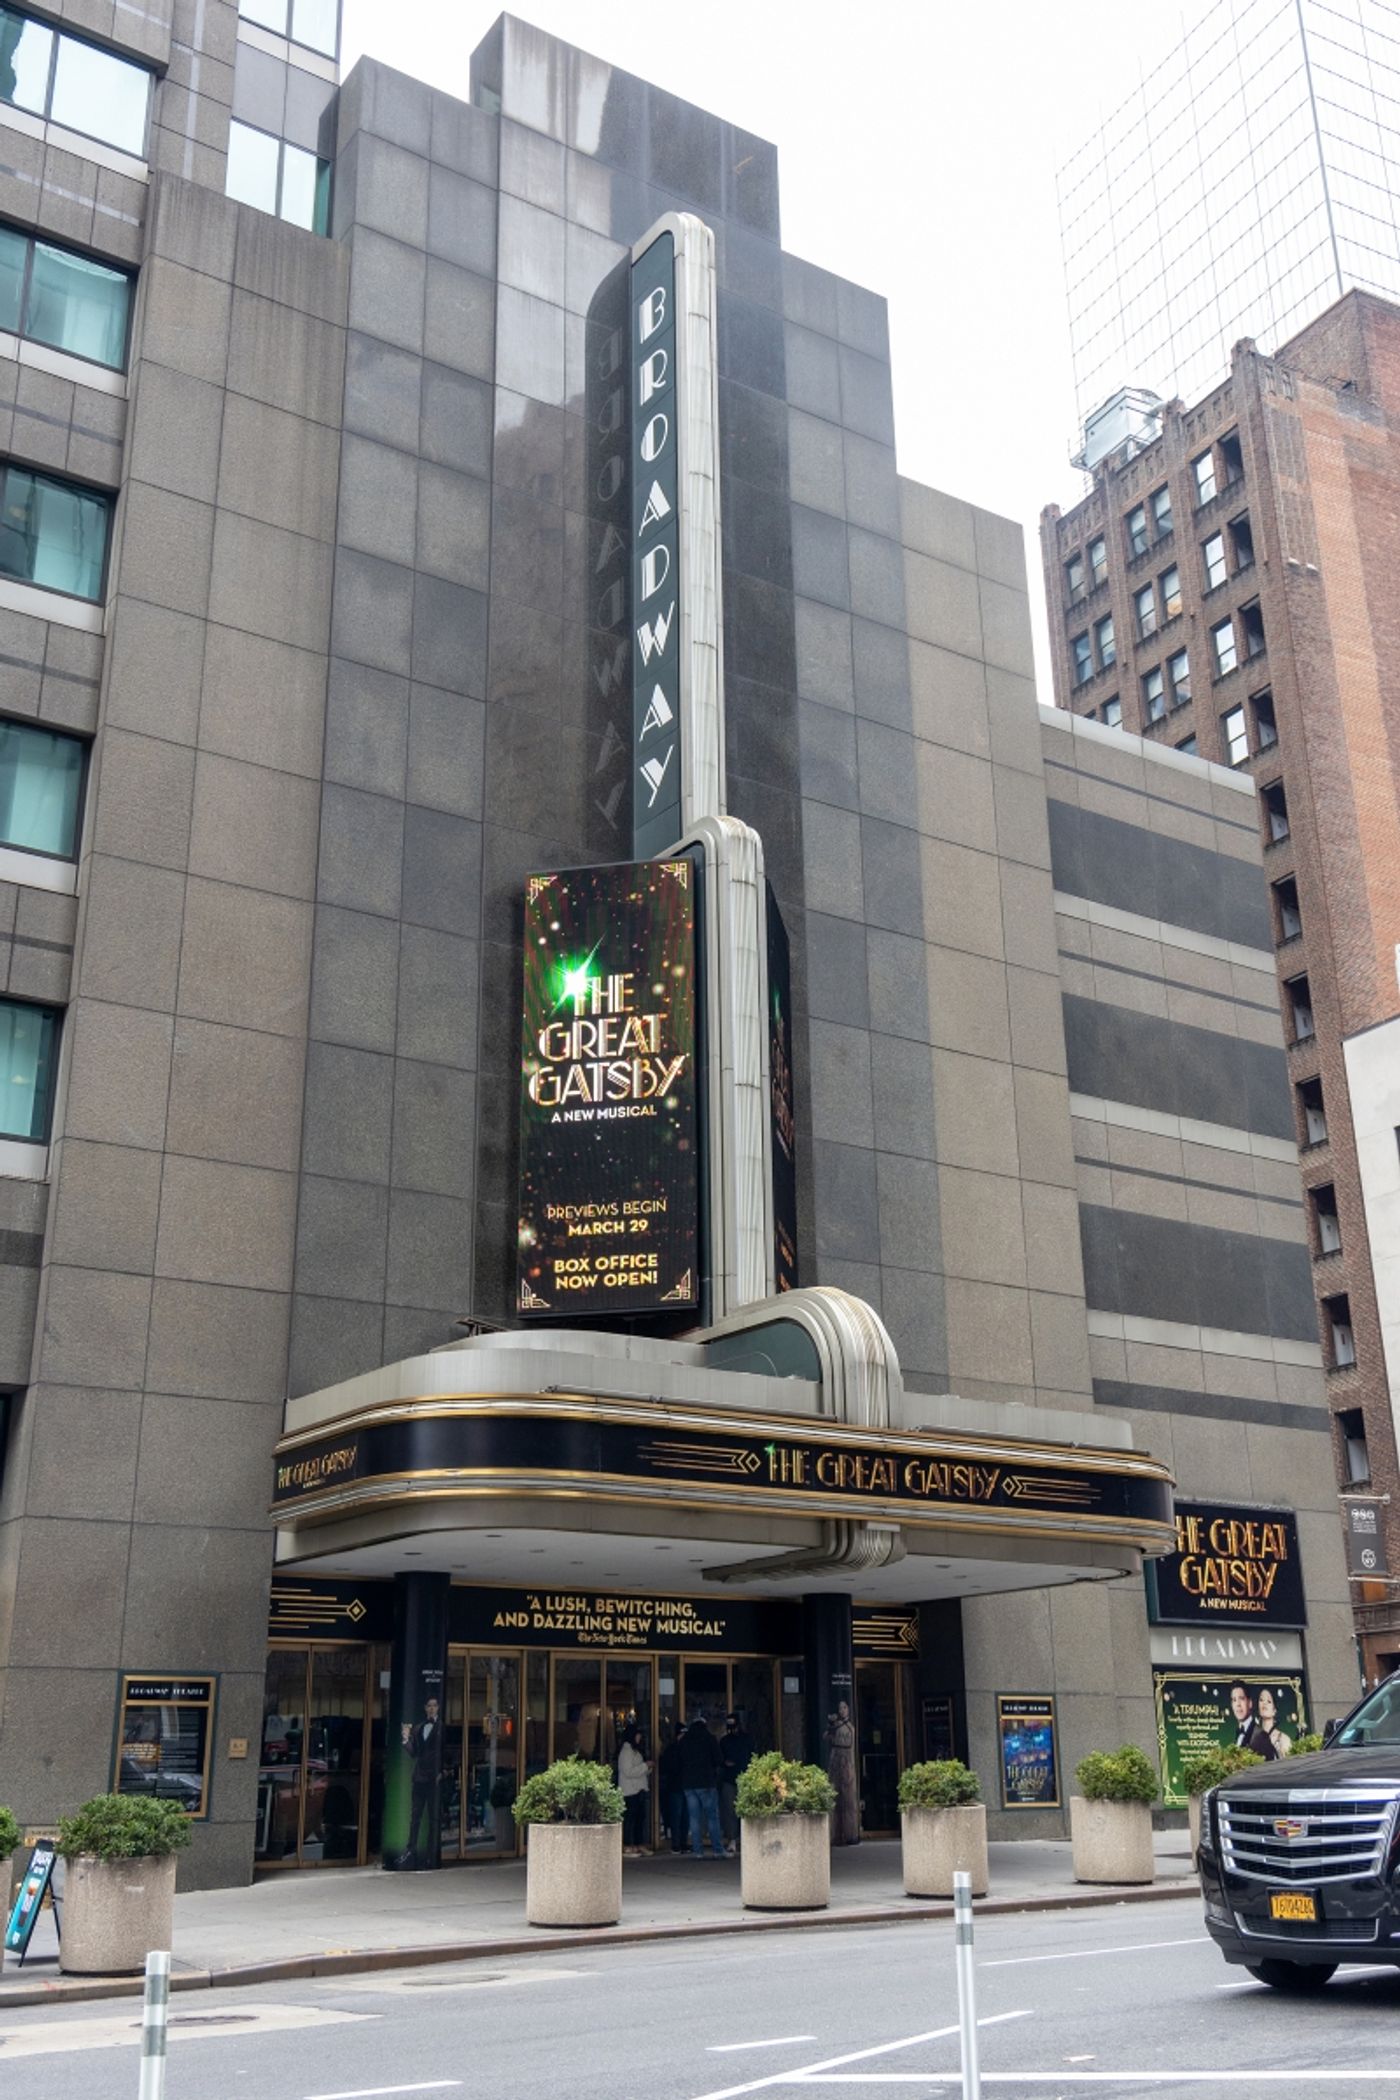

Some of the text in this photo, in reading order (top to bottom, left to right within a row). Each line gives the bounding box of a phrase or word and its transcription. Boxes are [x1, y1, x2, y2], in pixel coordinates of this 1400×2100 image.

[637, 286, 676, 809] BROADWAY
[567, 971, 635, 1016] THE
[538, 1013, 668, 1062] GREAT
[528, 1055, 686, 1106] GATSBY
[551, 1104, 657, 1124] A NEW MUSICAL
[547, 1199, 667, 1219] PREVIEWS BEGIN
[568, 1218, 649, 1237] MARCH 29
[554, 1253, 659, 1274] BOX OFFICE
[556, 1270, 658, 1290] NOW OPEN!
[768, 1446, 1000, 1500] THE GREAT GATSBY
[1175, 1515, 1288, 1560] HE GREAT
[1179, 1556, 1278, 1599] GATSBY
[546, 1596, 592, 1614] LUSH,
[595, 1598, 698, 1619] BEWITCHING,
[1200, 1598, 1267, 1612] A NEW MUSICAL
[493, 1612, 726, 1636] AND DAZZLING NEW MUSICAL"
